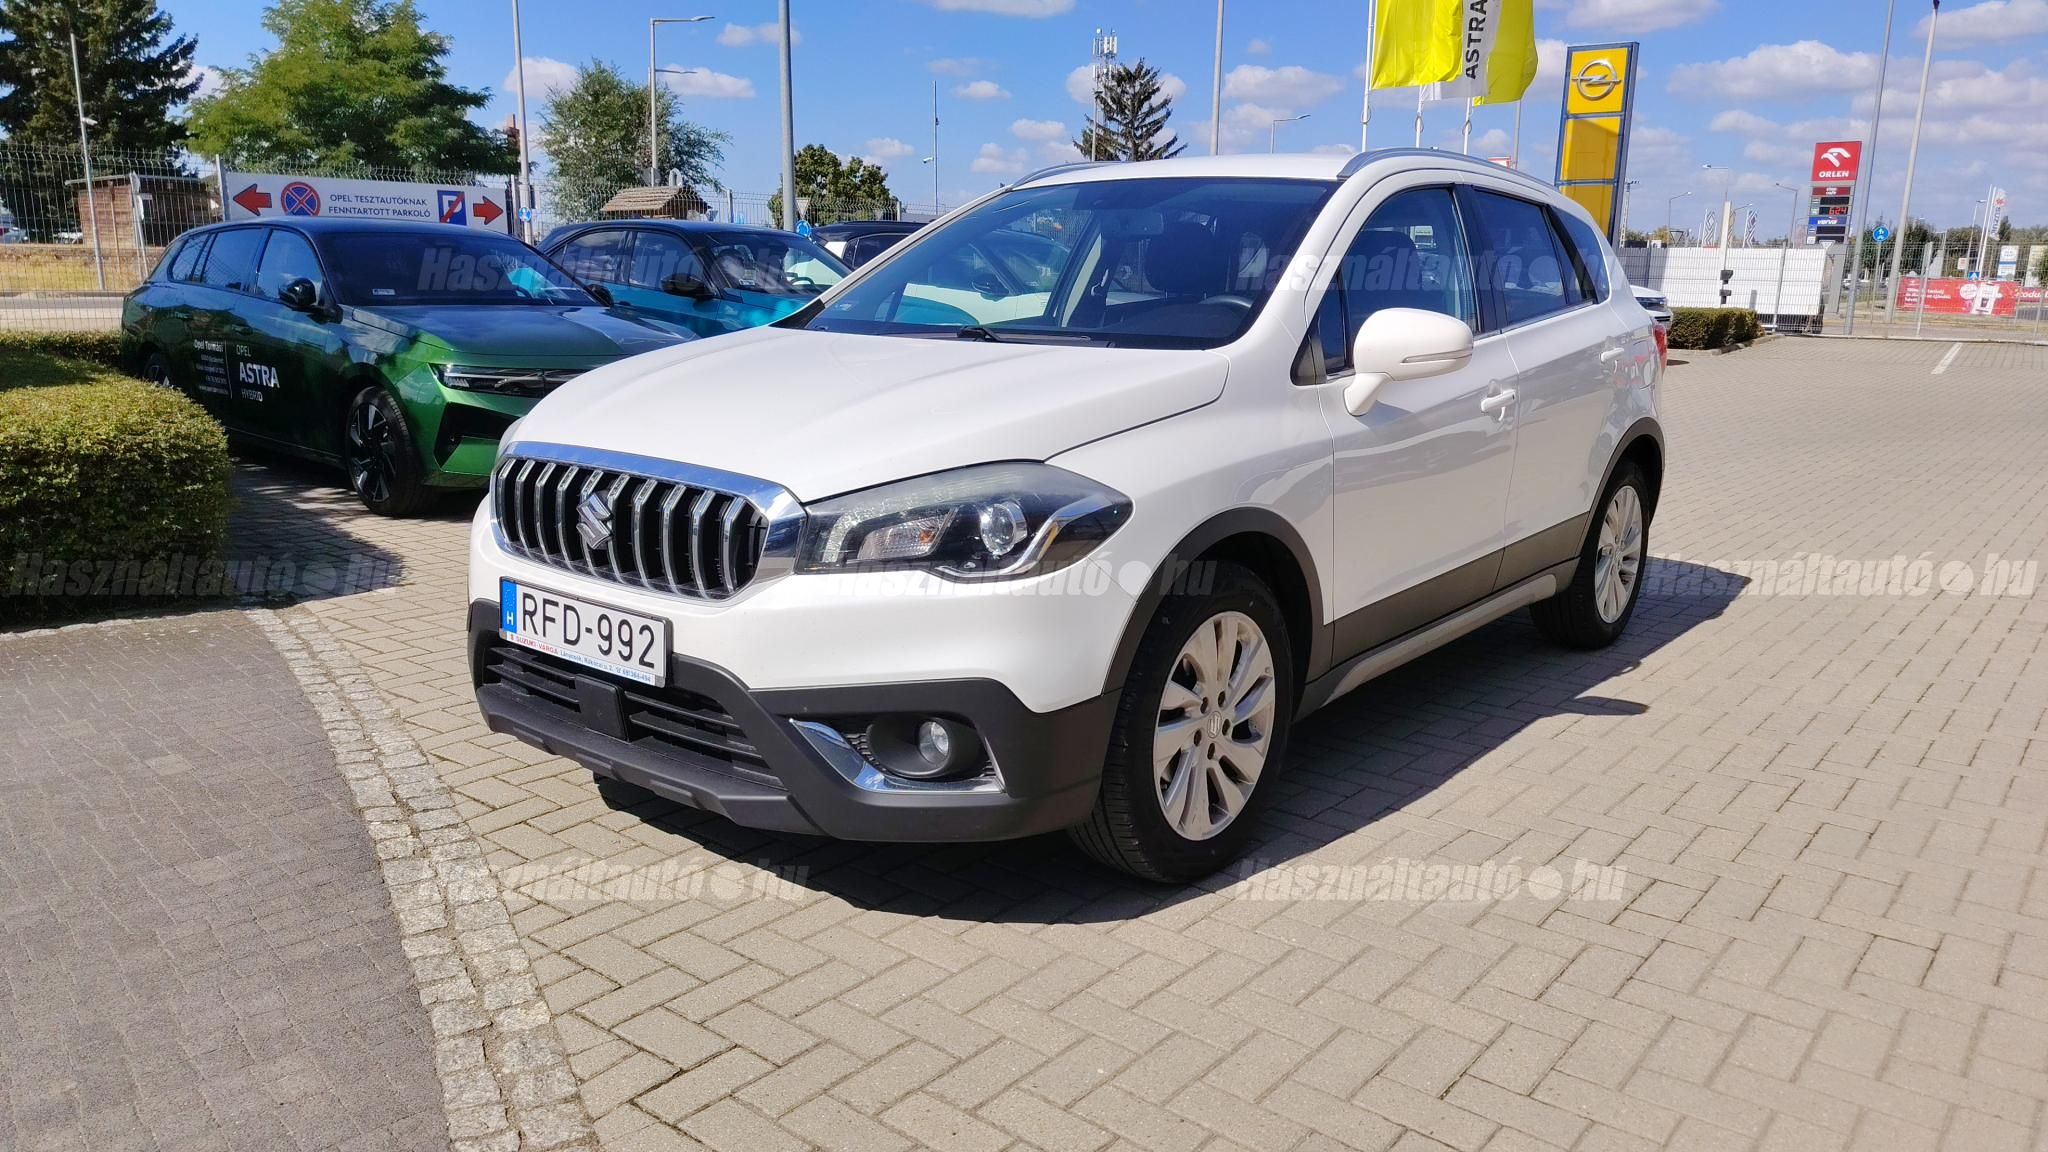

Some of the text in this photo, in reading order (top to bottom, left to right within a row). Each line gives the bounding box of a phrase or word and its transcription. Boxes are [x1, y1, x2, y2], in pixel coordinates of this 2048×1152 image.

[1465, 0, 1488, 80] ASTRA
[1818, 170, 1850, 178] ORLEN
[330, 194, 427, 206] OPEL TESZTAUTÓKNAK
[328, 206, 431, 218] FENNTARTOTT PARKOLÓ
[236, 344, 251, 357] OPEL
[239, 362, 280, 388] ASTRA
[242, 388, 263, 402] HYBRID
[506, 611, 514, 626] H
[522, 592, 655, 669] RFD-992
